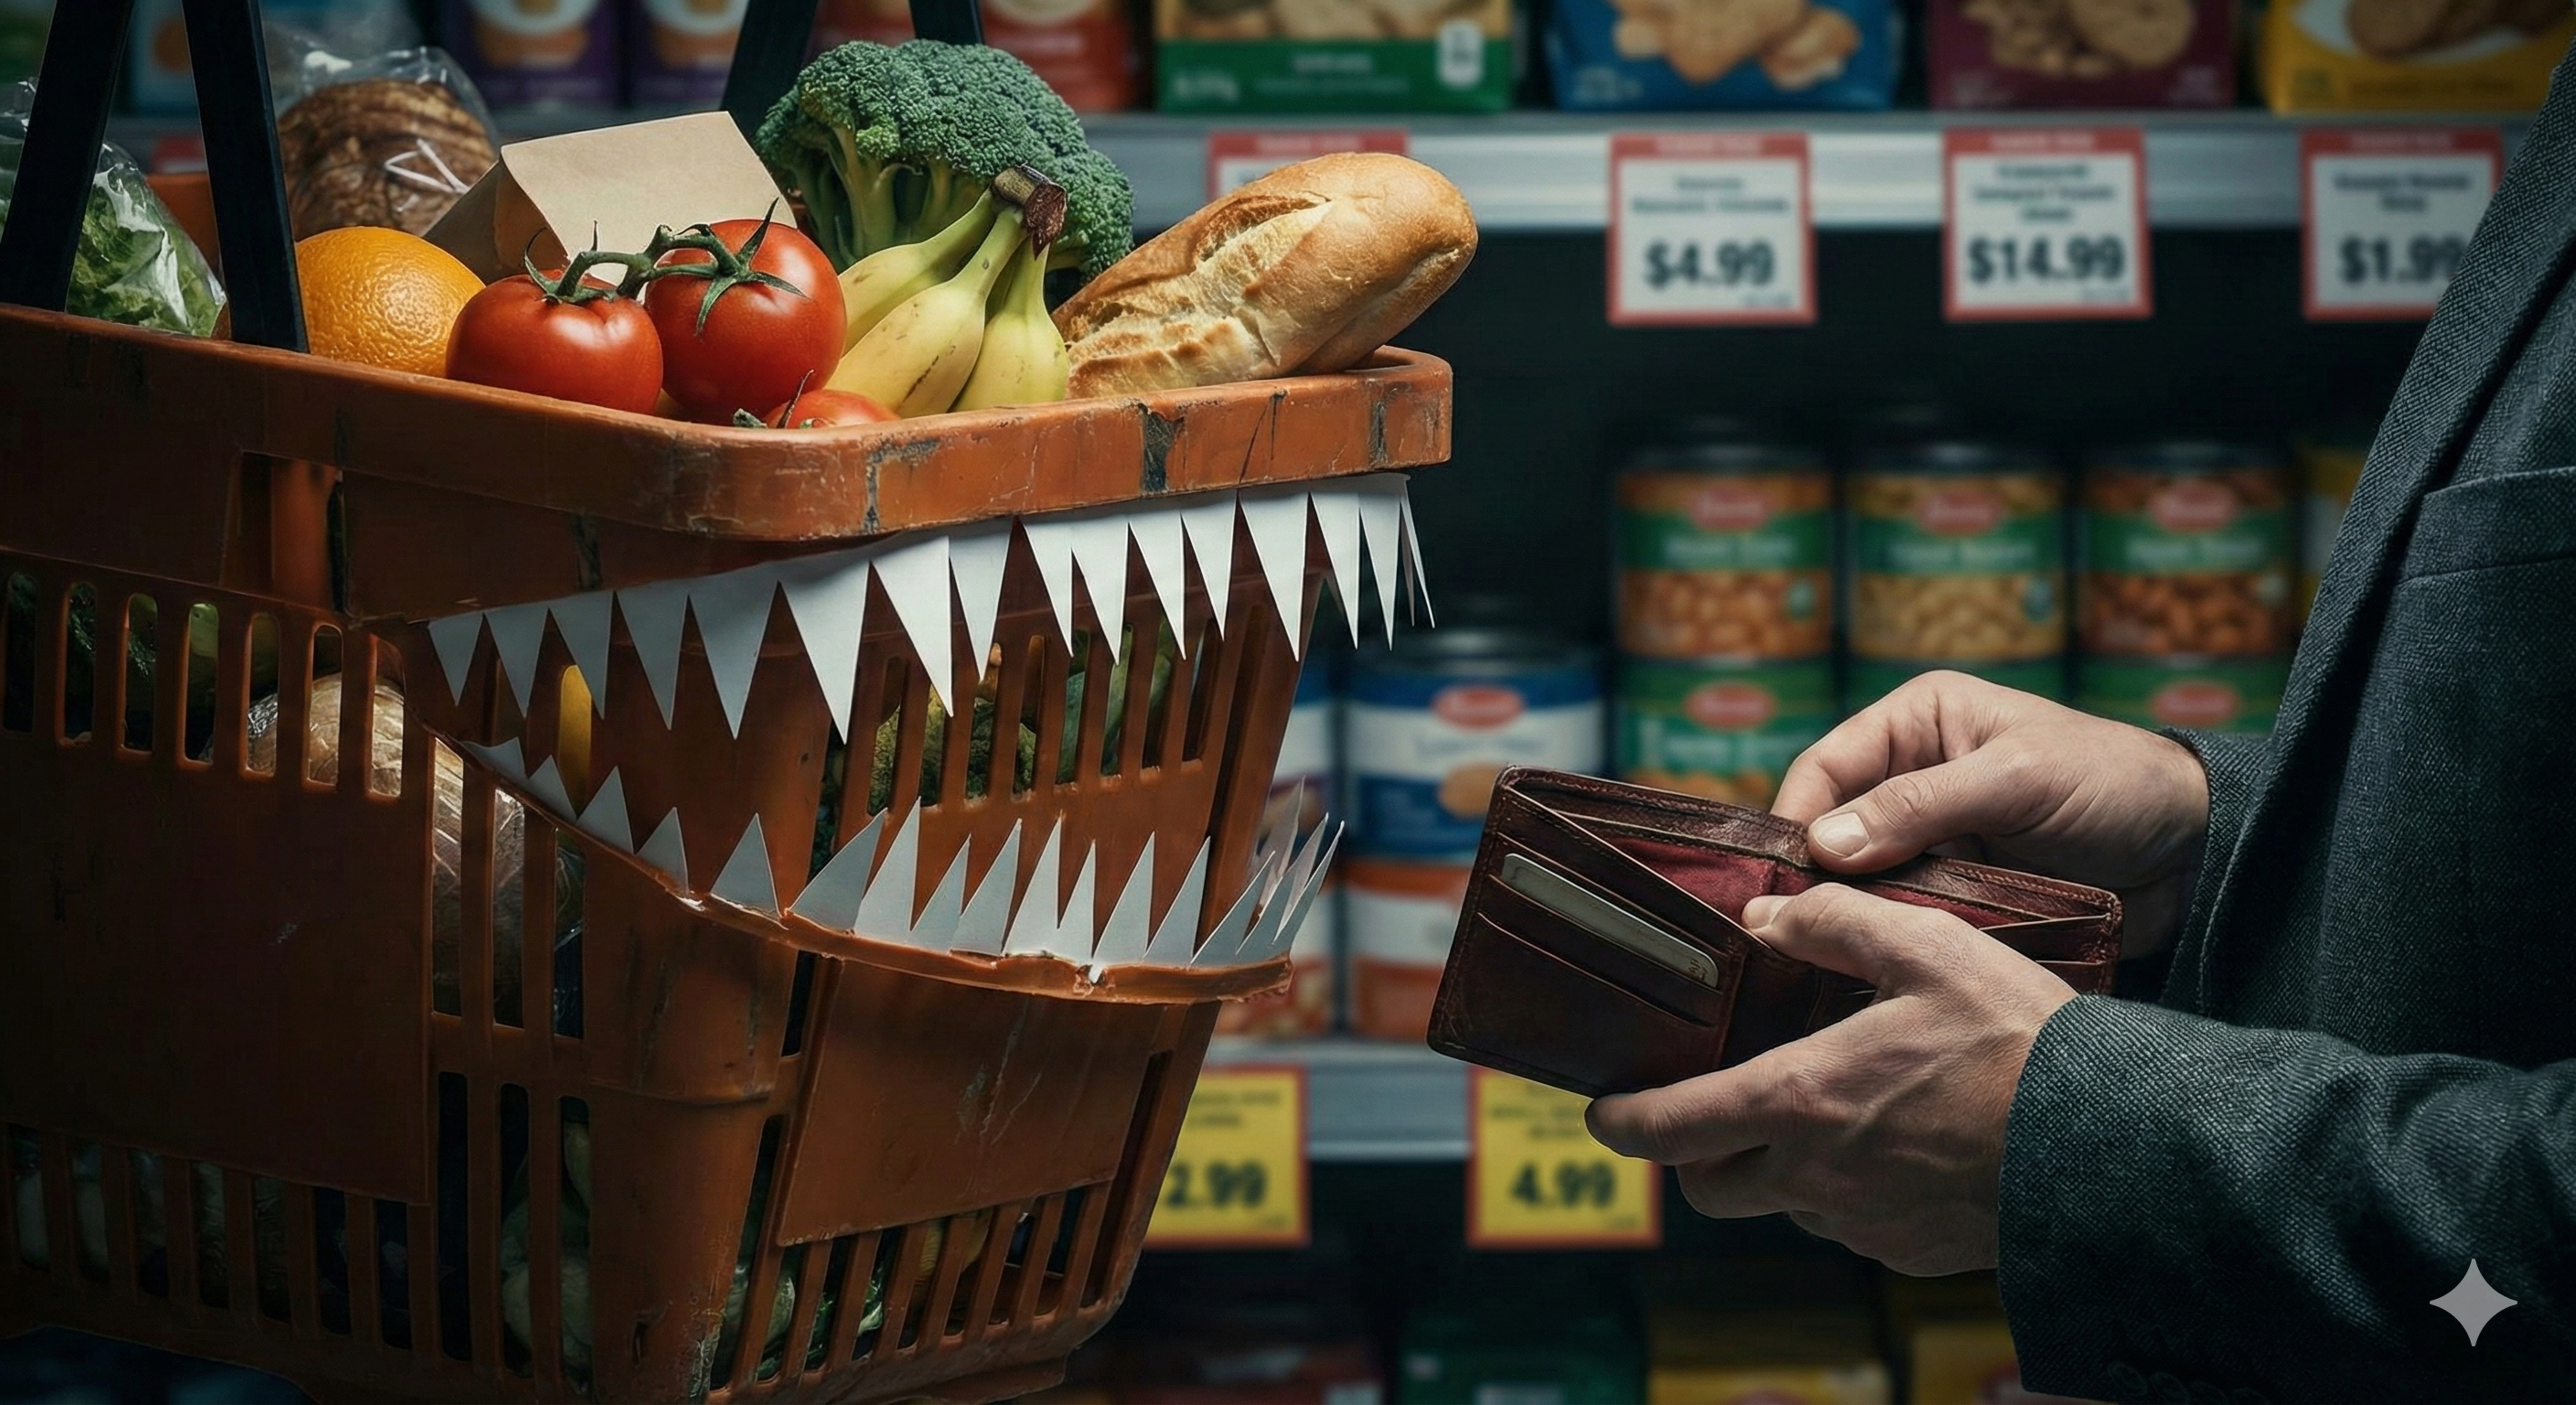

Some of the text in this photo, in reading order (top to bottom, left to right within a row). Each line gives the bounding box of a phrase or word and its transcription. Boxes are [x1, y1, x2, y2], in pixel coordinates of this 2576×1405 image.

[1646, 241, 1774, 292] $4.99
[1970, 234, 2123, 286] $14.99
[1508, 1159, 1616, 1210] 4.99
